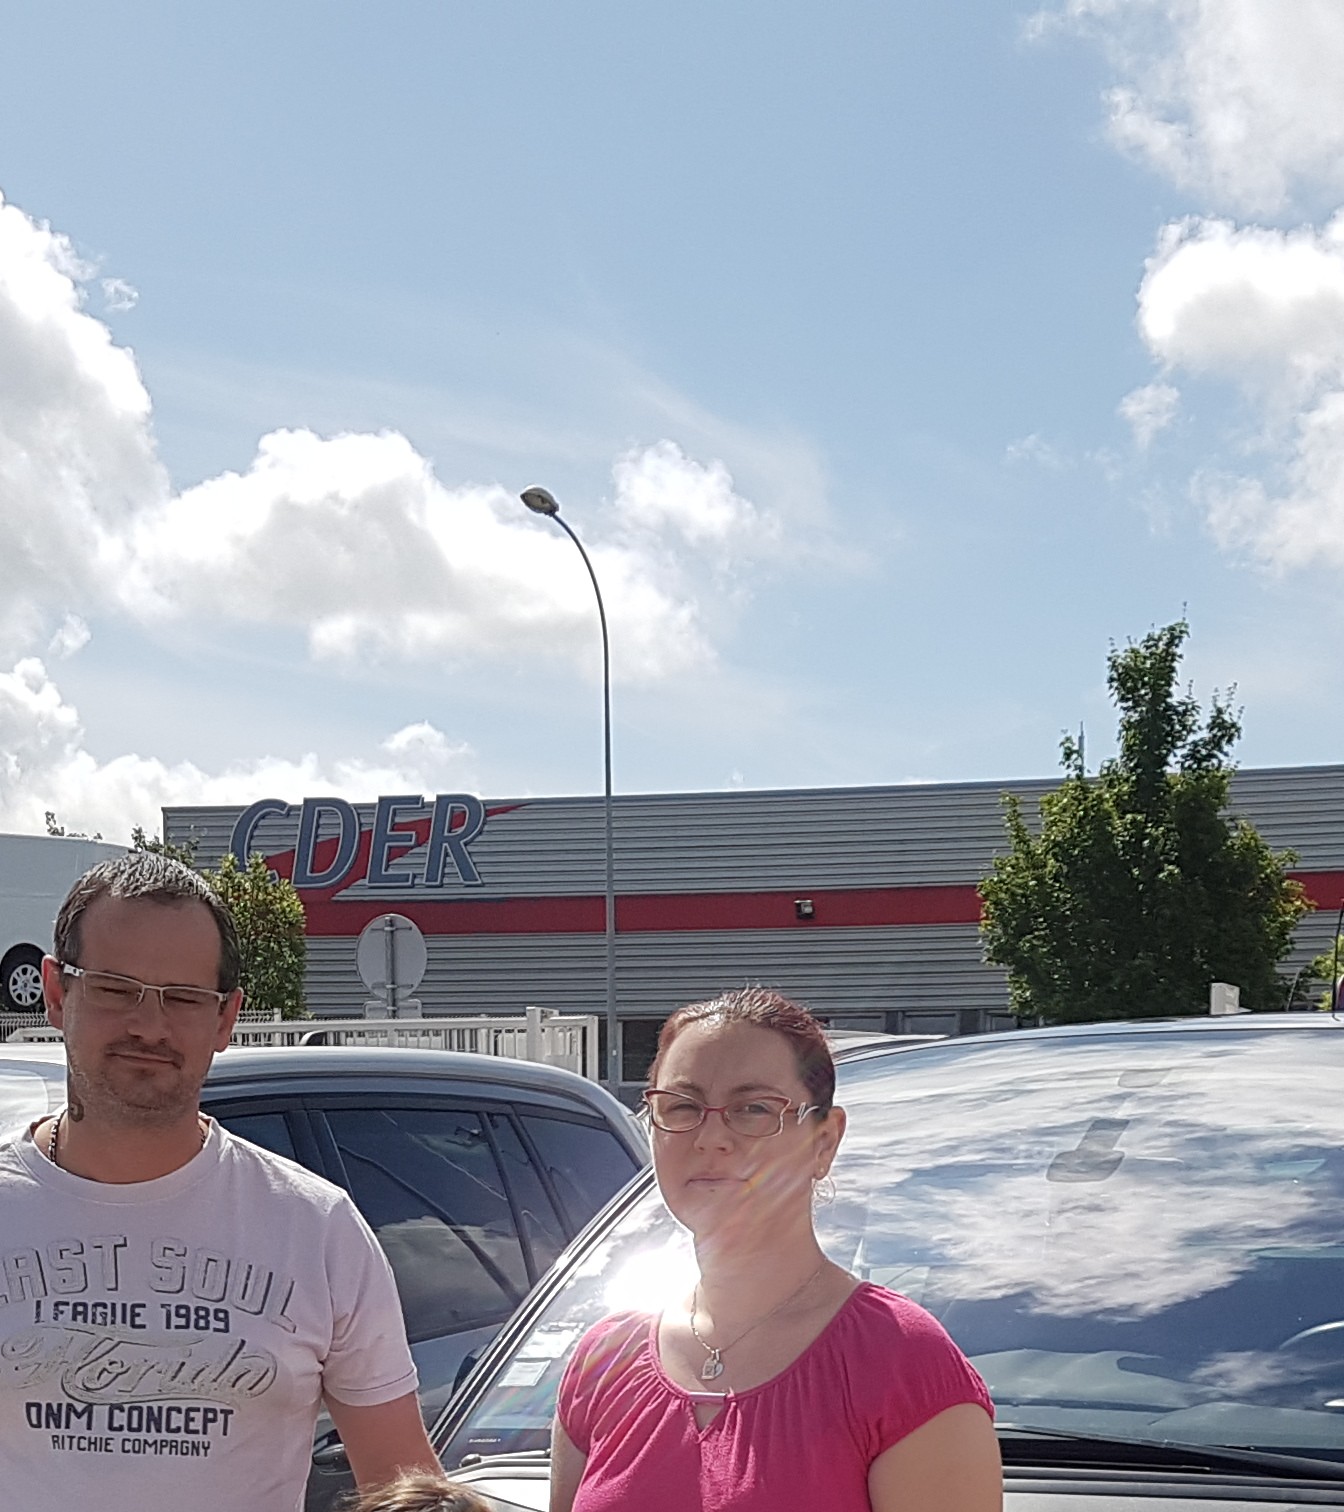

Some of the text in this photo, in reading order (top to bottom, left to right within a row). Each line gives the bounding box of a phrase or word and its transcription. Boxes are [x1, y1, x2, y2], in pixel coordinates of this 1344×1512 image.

[229, 793, 487, 888] CDER
[150, 1238, 297, 1334] SOUL
[160, 1303, 231, 1334] 1989
[107, 1403, 235, 1437] CONCEPT
[51, 1435, 212, 1458] RITCHIE COMPAGNY
